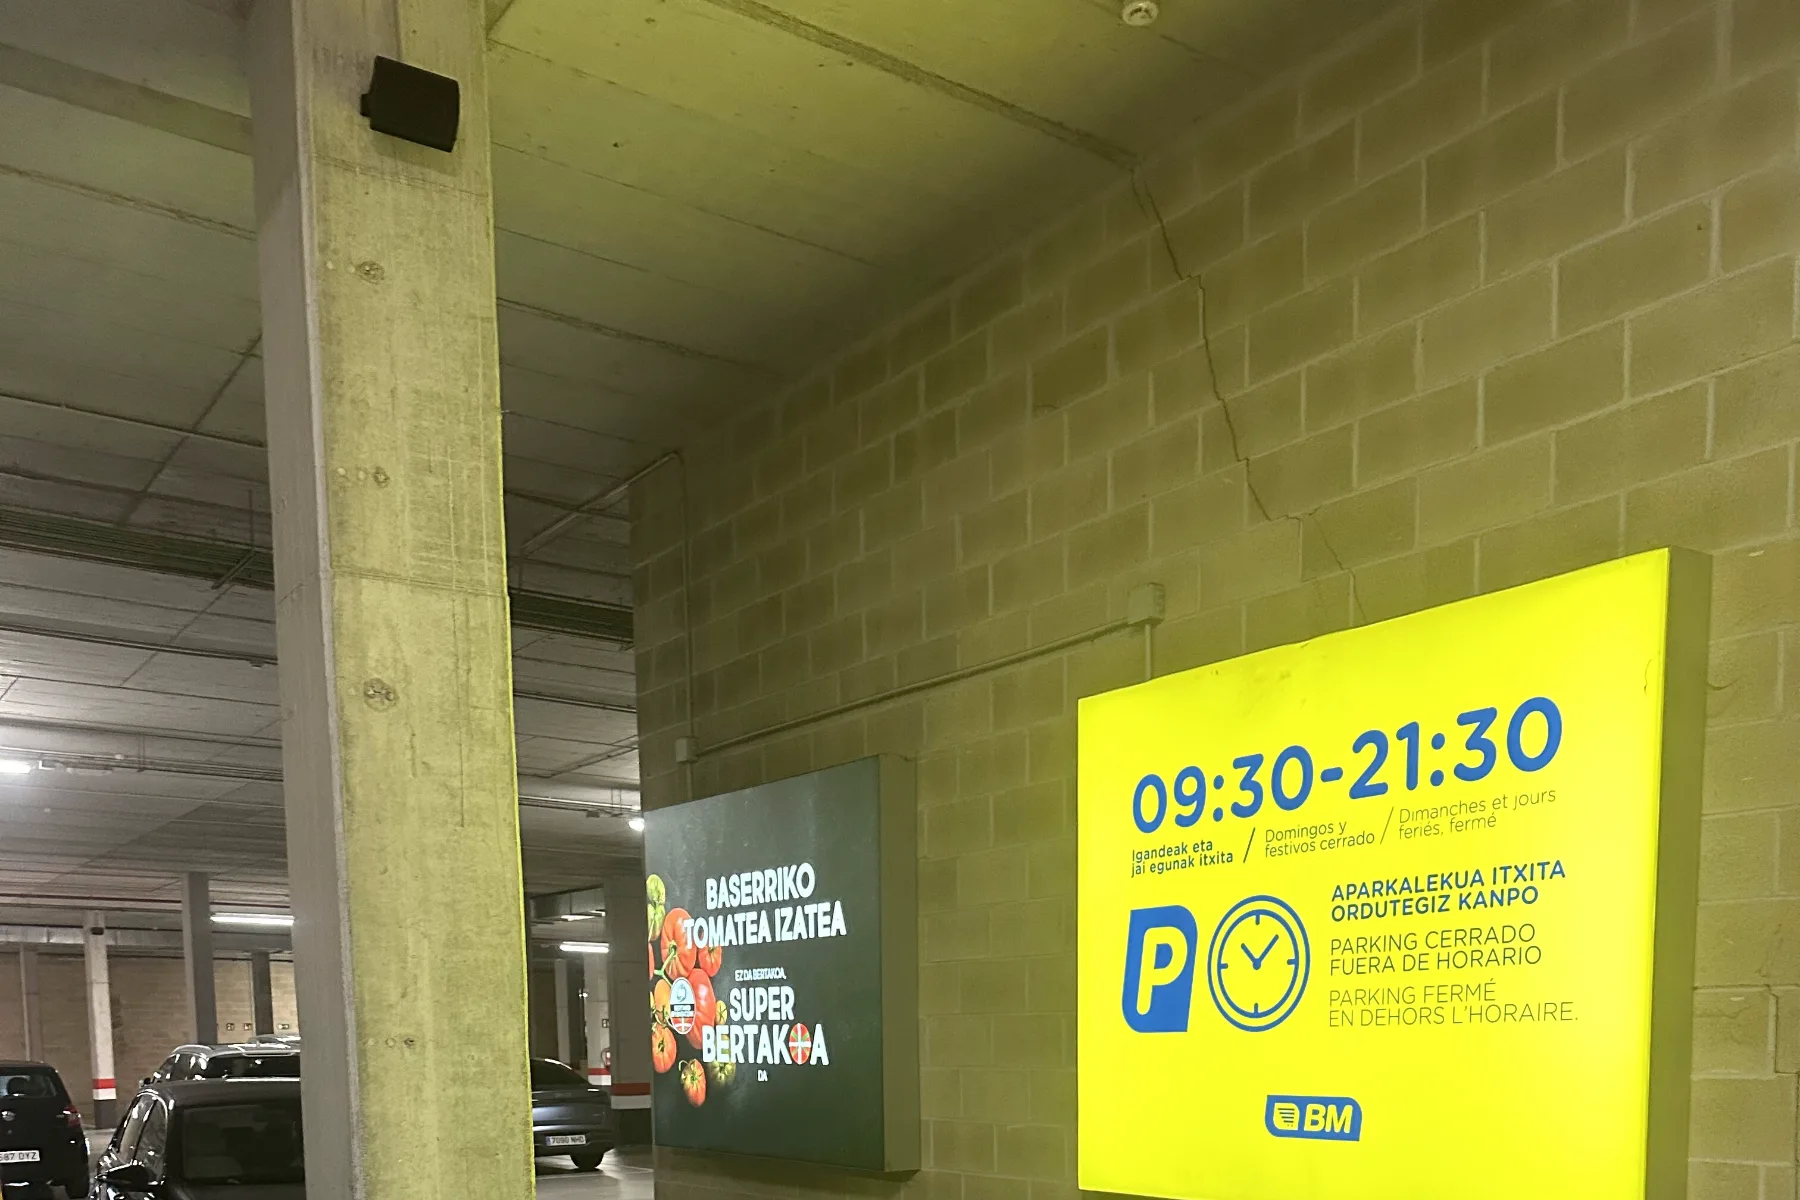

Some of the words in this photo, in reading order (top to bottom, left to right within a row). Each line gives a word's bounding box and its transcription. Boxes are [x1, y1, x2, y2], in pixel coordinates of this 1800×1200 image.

[1132, 696, 1563, 834] 09:30-21:30
[1399, 800, 1486, 824] Dimanches
[1491, 794, 1509, 810] et
[1512, 790, 1556, 811] jours
[1265, 822, 1334, 843] Domingos
[1338, 821, 1347, 834] y
[1398, 820, 1444, 840] feriés,
[1449, 812, 1497, 833] fermé
[1132, 841, 1188, 864] Igandeak
[1192, 839, 1213, 854] eta
[1265, 840, 1316, 858] festivos
[1319, 830, 1375, 851] cerrado
[1130, 862, 1146, 879] jai
[1149, 854, 1195, 875] egunak
[1199, 850, 1234, 867] itxita
[706, 862, 816, 910] BASERRIKO
[1331, 868, 1485, 903] APARKALEKUA
[1492, 859, 1566, 886] ITXITA
[1331, 893, 1451, 923] ORDUTEGIZ
[1458, 885, 1539, 911] KANPO
[684, 909, 771, 949] TOMATEA
[774, 900, 848, 943] IZATEA
[1330, 932, 1418, 956] PARKING
[1424, 923, 1536, 950] CERRADO
[1330, 955, 1396, 977] FUERA
[1402, 952, 1430, 972] DE
[1436, 945, 1542, 970] HORARIO
[729, 986, 794, 1021] SUPER
[1329, 986, 1416, 1007] PARKING
[1423, 978, 1497, 1004] FERMÉ
[1329, 1009, 1354, 1028] EN
[1360, 1006, 1445, 1027] DEHORS
[1452, 1001, 1578, 1025] L'HORAIRE.
[757, 1070, 768, 1082] DA
[1303, 1103, 1353, 1133] BM
